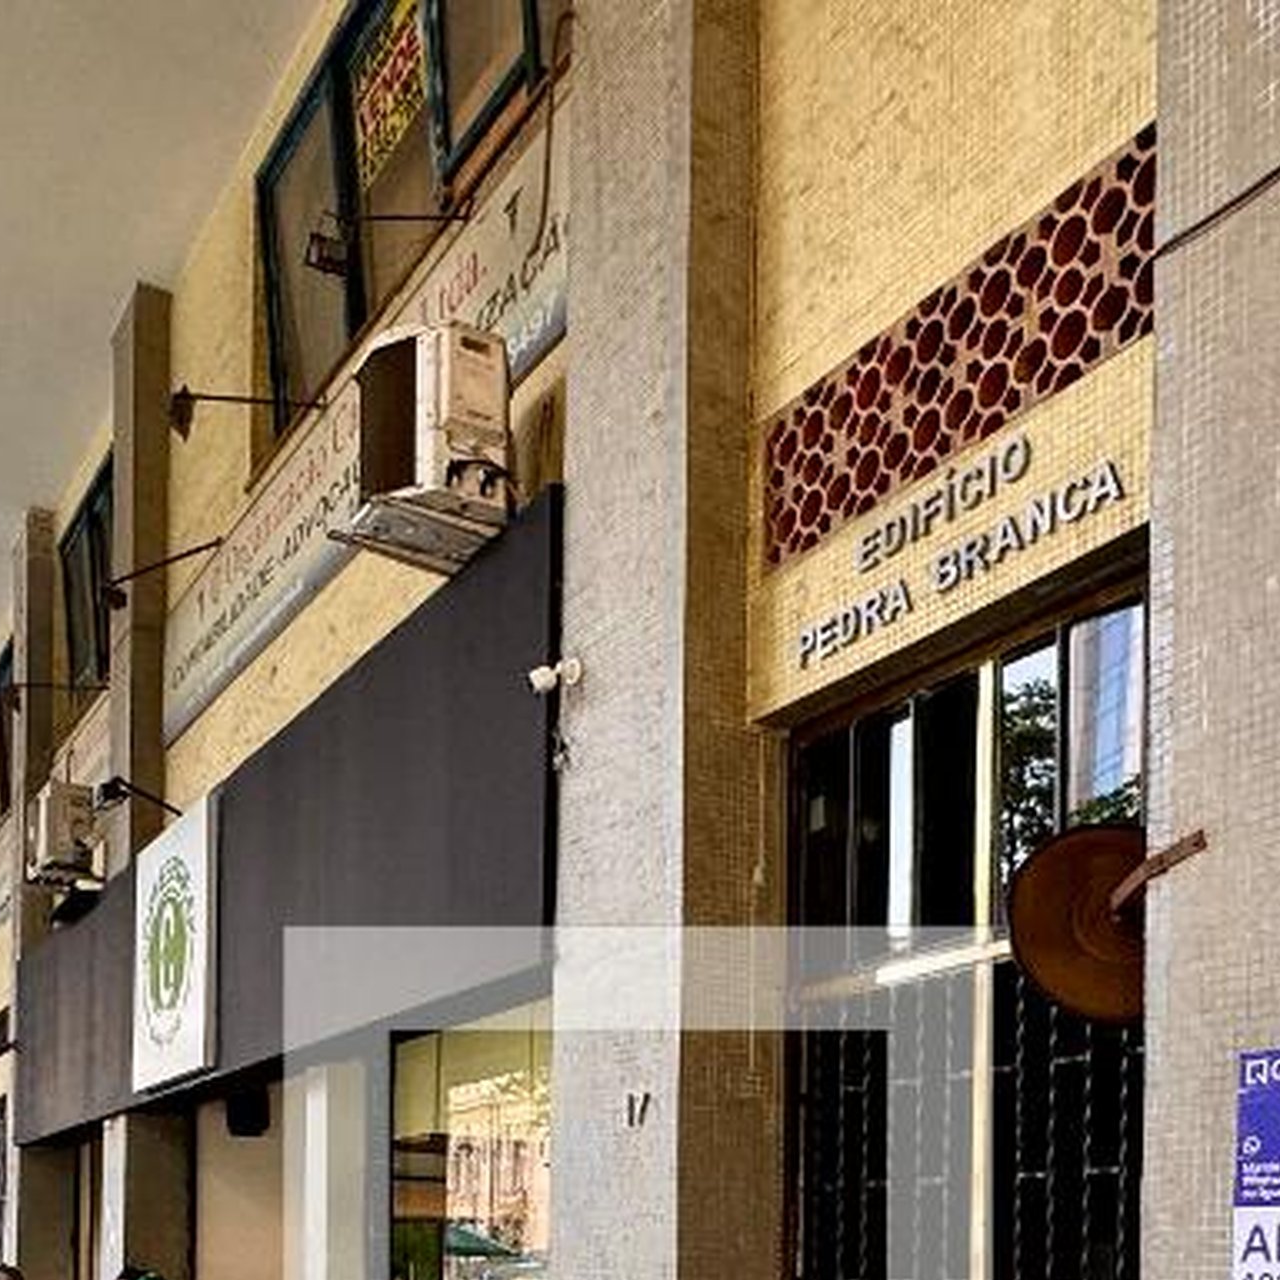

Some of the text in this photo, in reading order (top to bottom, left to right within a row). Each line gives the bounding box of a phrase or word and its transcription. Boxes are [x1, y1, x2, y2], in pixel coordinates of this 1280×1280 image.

[797, 458, 1126, 670] PEDRA BRANCA
[856, 432, 1032, 573] EDIFÍCIO
